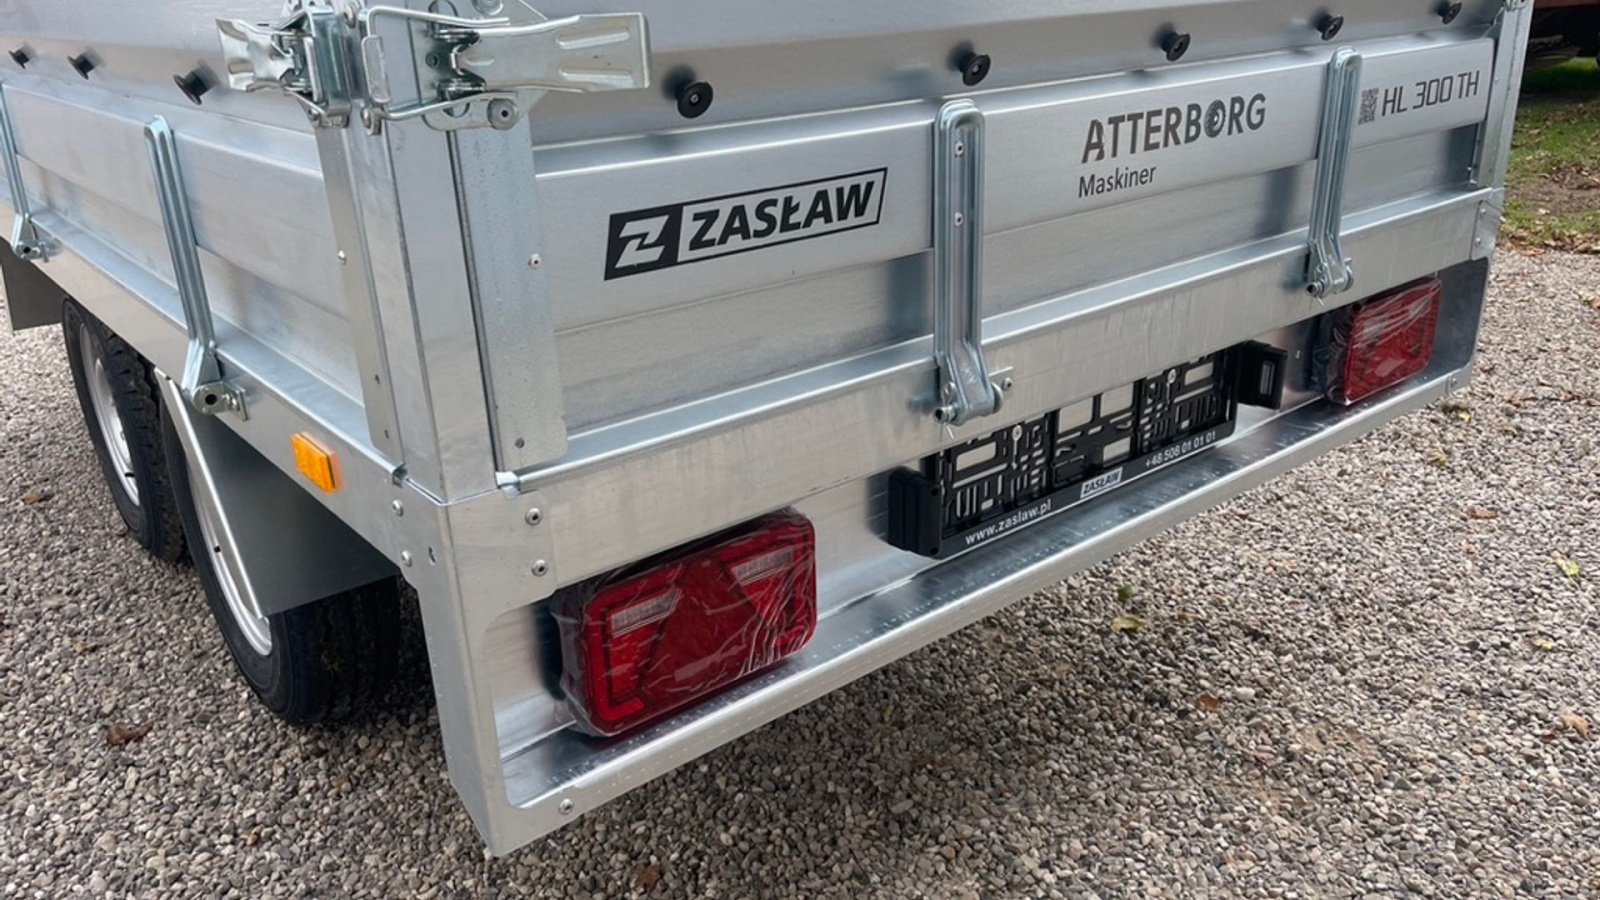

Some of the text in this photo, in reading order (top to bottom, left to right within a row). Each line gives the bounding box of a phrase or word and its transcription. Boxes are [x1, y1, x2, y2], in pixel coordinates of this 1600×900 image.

[1381, 70, 1480, 116] HL 300 TH
[1081, 93, 1266, 164] ATTERBORG
[1078, 166, 1157, 198] Maskiner
[689, 180, 875, 251] ZASŁAW
[1181, 440, 1192, 453] 01
[1193, 436, 1204, 448] 01
[1205, 430, 1216, 442] 01
[965, 498, 1051, 545] www.zaslaw.pl
